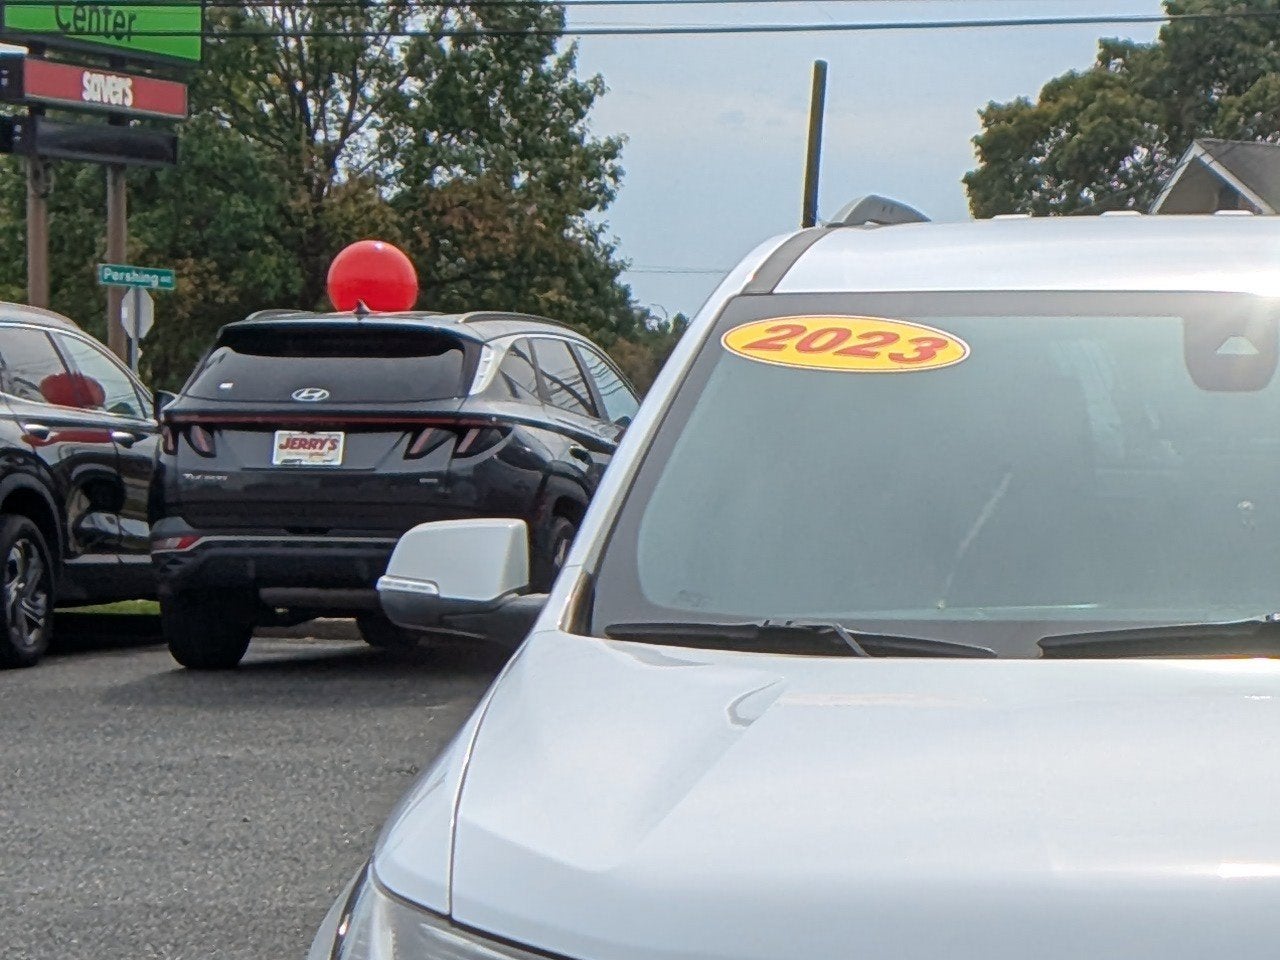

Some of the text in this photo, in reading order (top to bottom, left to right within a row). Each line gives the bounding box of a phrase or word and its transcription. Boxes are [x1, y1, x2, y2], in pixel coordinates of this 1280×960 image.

[104, 267, 159, 287] Pershing
[742, 323, 949, 364] 2023
[279, 437, 340, 450] JERRY'S
